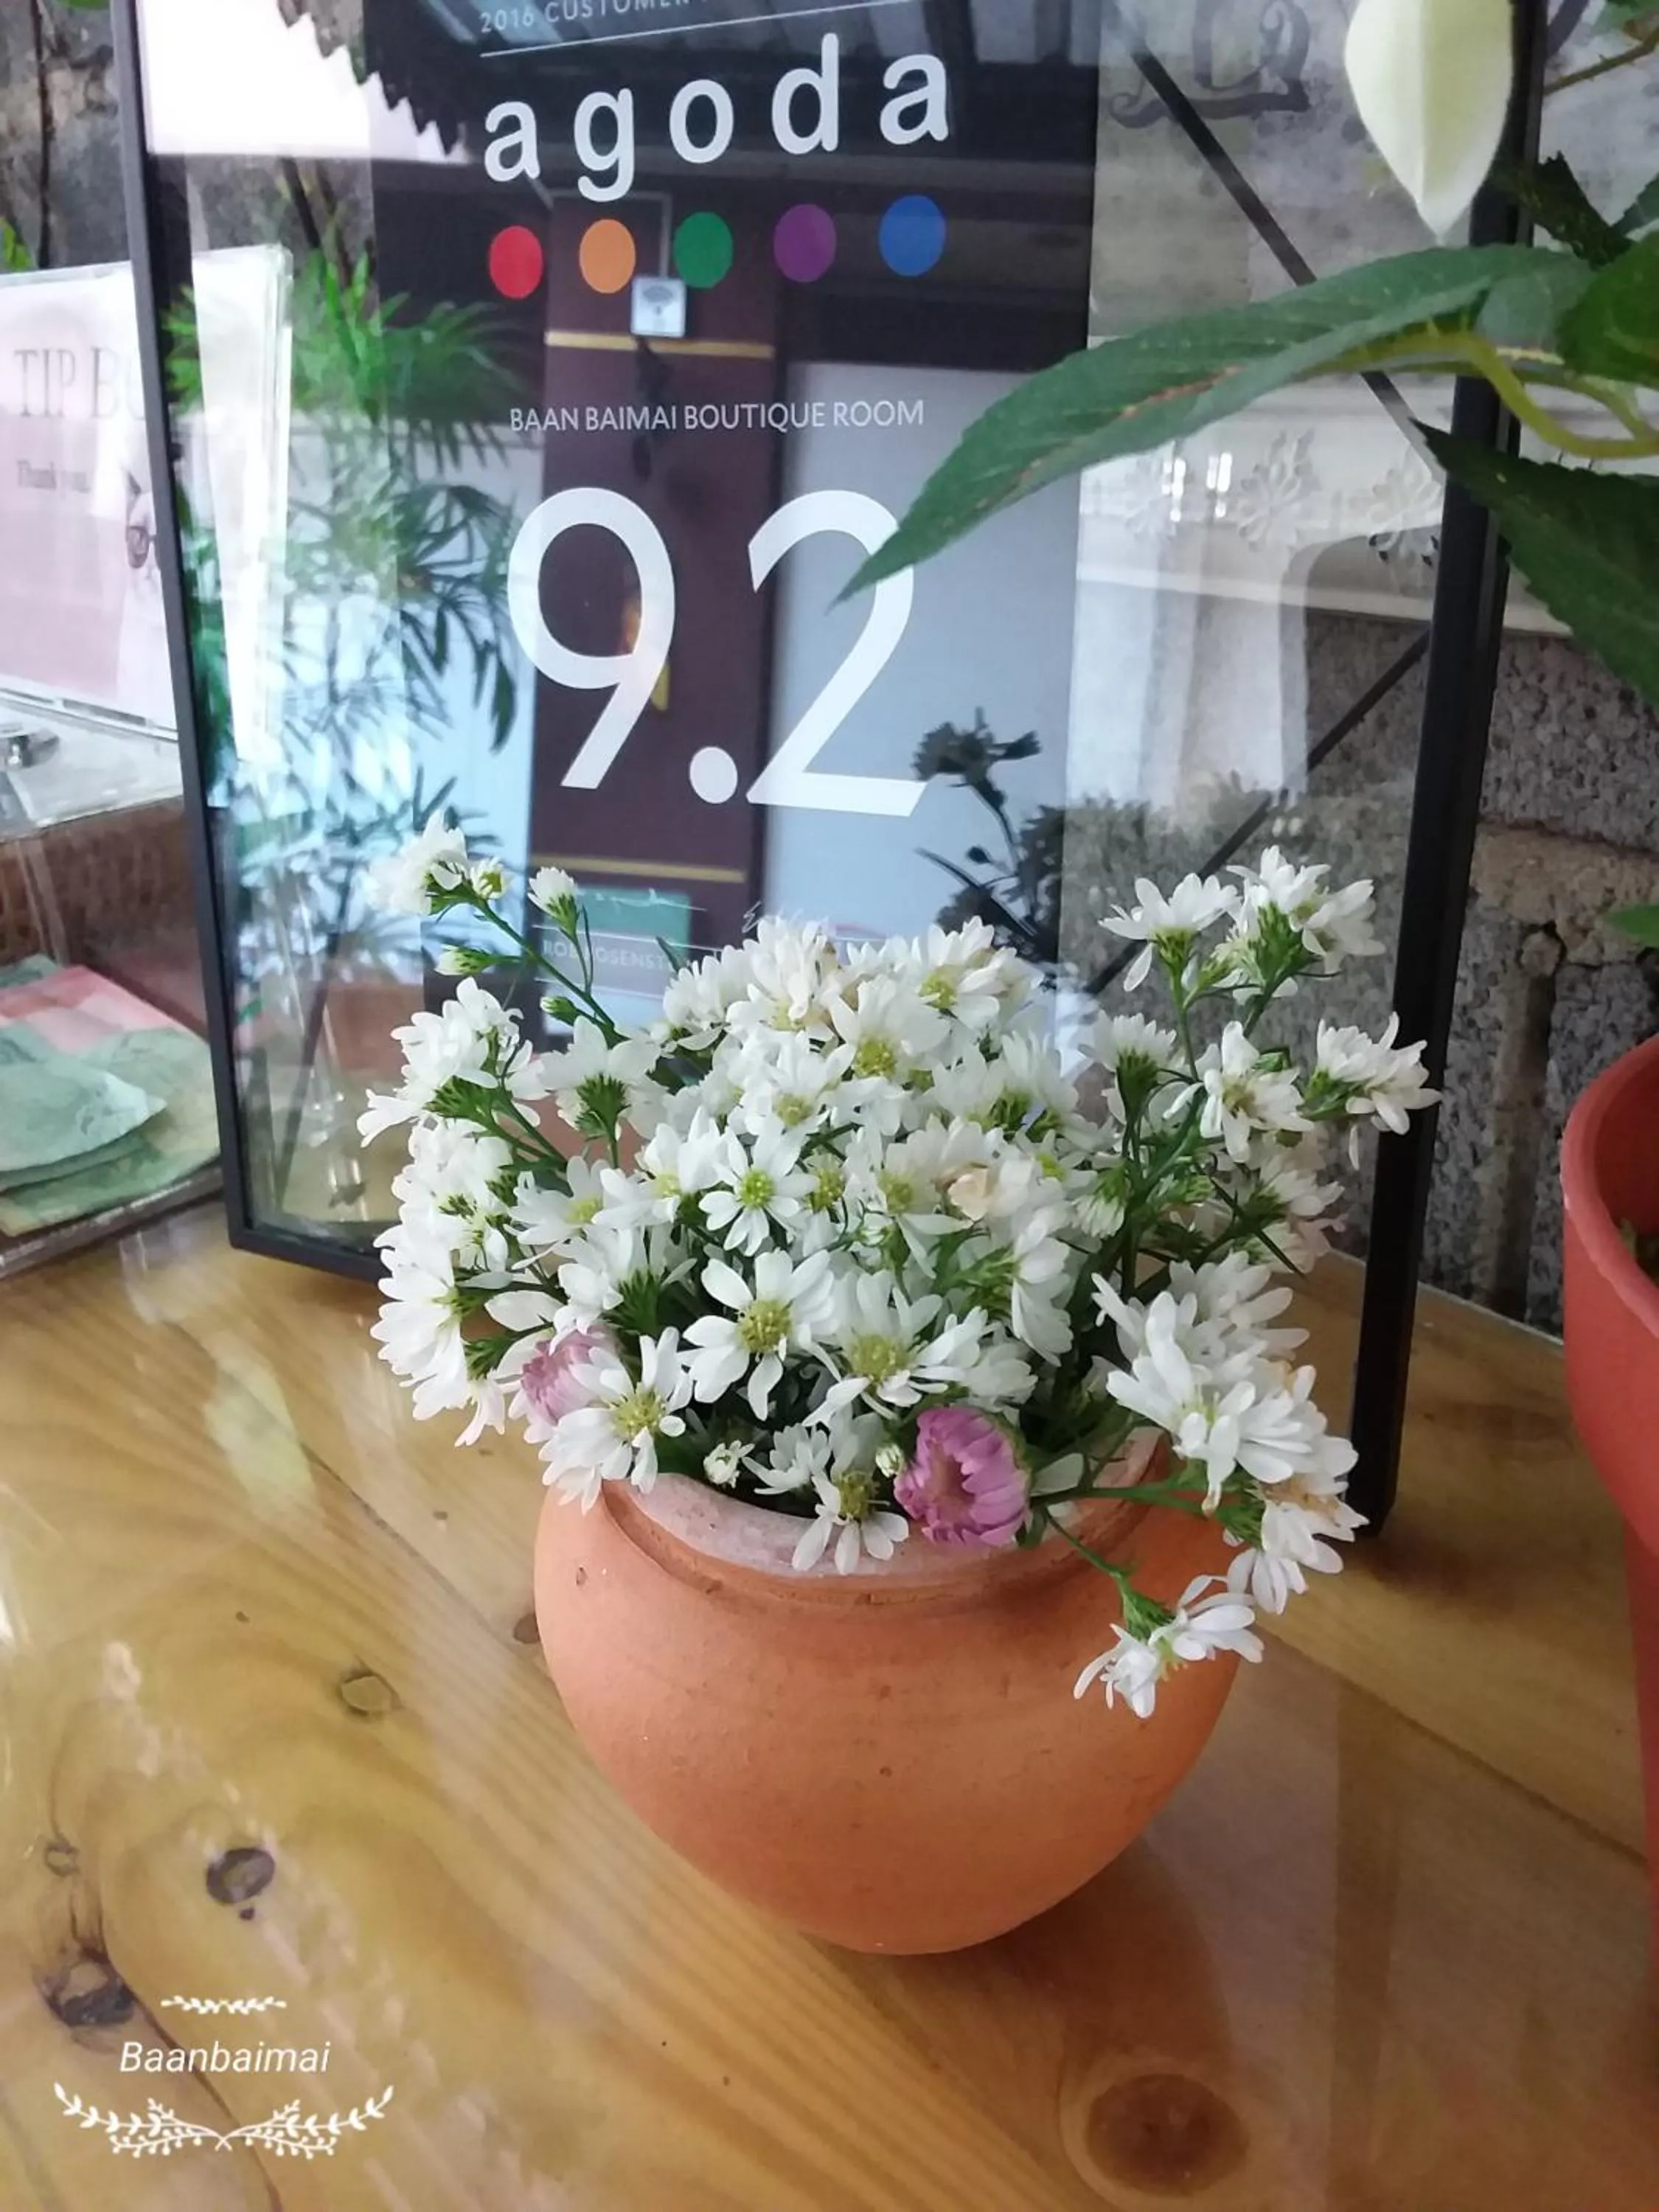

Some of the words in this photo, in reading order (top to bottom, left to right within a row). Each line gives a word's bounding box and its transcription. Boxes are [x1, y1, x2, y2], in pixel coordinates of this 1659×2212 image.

[479, 5, 535, 33] 2016
[544, 0, 690, 23] CUSTOM
[484, 32, 950, 203] agoda
[13, 347, 77, 417] TIP
[510, 407, 579, 432] BAAN
[585, 404, 678, 431] BAIMAI
[684, 402, 826, 434] BOUTIQUE
[832, 399, 925, 427] ROOM
[507, 487, 928, 818] 9.2
